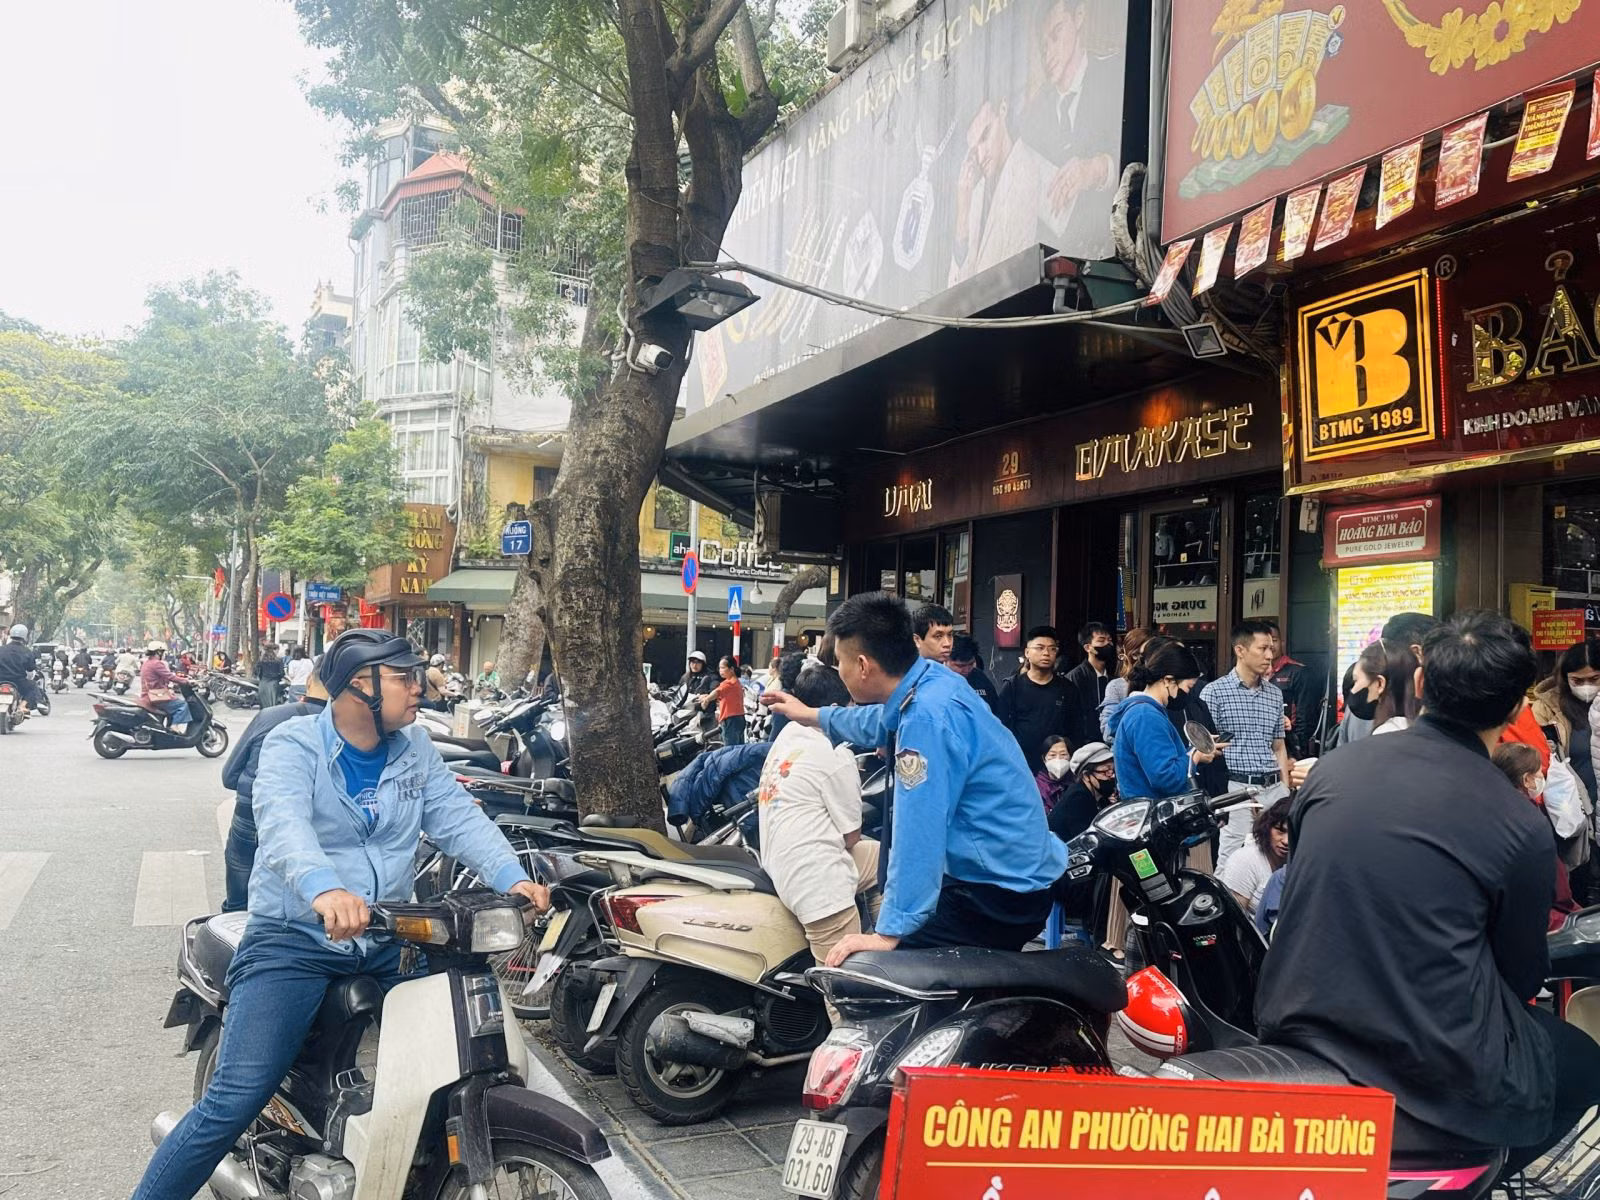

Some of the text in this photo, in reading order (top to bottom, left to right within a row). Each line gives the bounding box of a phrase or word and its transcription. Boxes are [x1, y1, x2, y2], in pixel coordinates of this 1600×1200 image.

[807, 107, 850, 159] VÀNG
[854, 54, 915, 123] TRANG
[1462, 249, 1600, 393] BẢ
[1319, 407, 1414, 441] BTMC 1989
[1463, 412, 1501, 436] KINH
[1502, 402, 1564, 430] DOANH
[1075, 402, 1253, 481] OMAKASE
[1002, 451, 1019, 476] 29
[1339, 516, 1423, 541] HOÀNG KIM BẢO
[1362, 515, 1381, 524] BTMC
[510, 540, 523, 550] 17
[1364, 543, 1383, 551] GOLD
[1384, 540, 1415, 550] JEWELRY
[751, 568, 768, 577] Coffee
[683, 918, 752, 933] LEAD
[796, 1126, 836, 1158] 29-AB
[923, 1099, 1376, 1156] CÔNG AN PHƯỜNG HAI BÀ TRƯNG
[785, 1158, 833, 1193] 031.60
